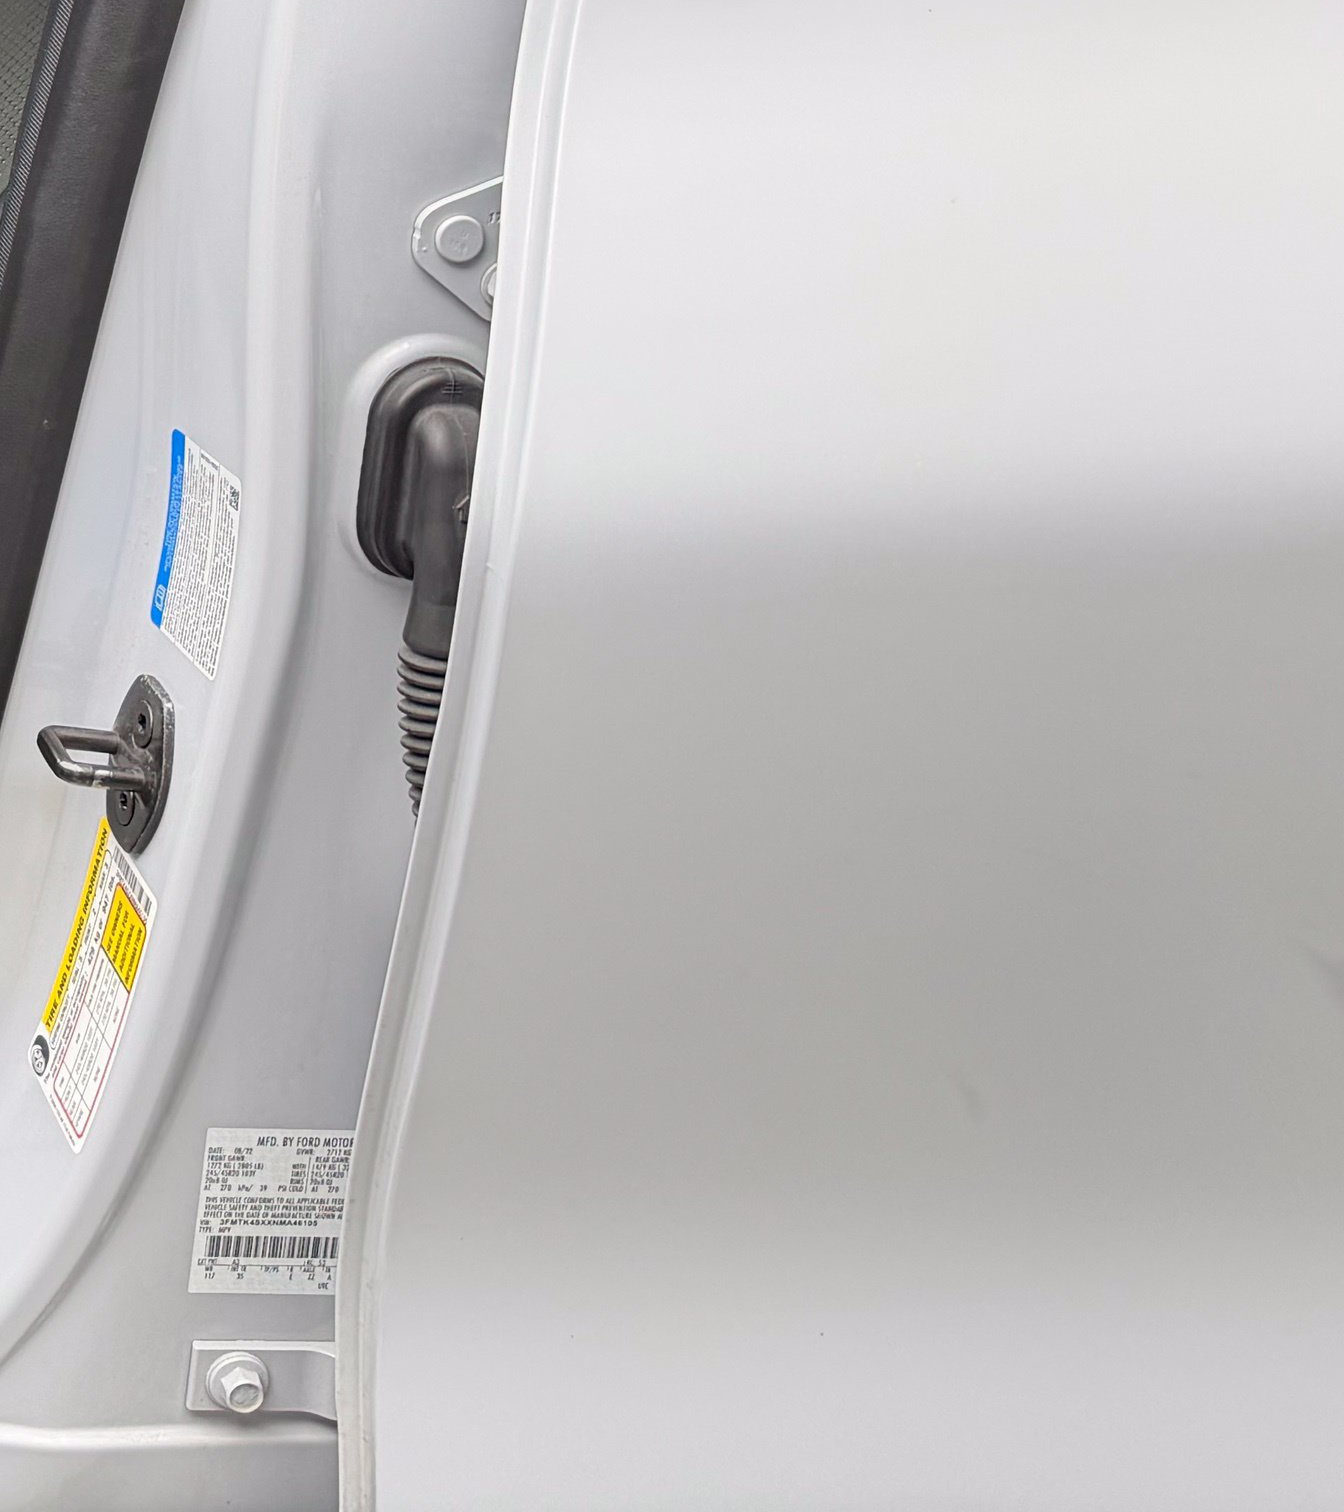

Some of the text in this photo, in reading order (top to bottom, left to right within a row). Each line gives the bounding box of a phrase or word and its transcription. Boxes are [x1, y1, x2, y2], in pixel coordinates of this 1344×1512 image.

[45, 828, 108, 1029] TIRE AND LOADING INFORMATION
[256, 1136, 279, 1147] MFD.
[282, 1136, 294, 1147] BY
[297, 1137, 321, 1148] FORD
[296, 1197, 329, 1205] APPLICABLE
